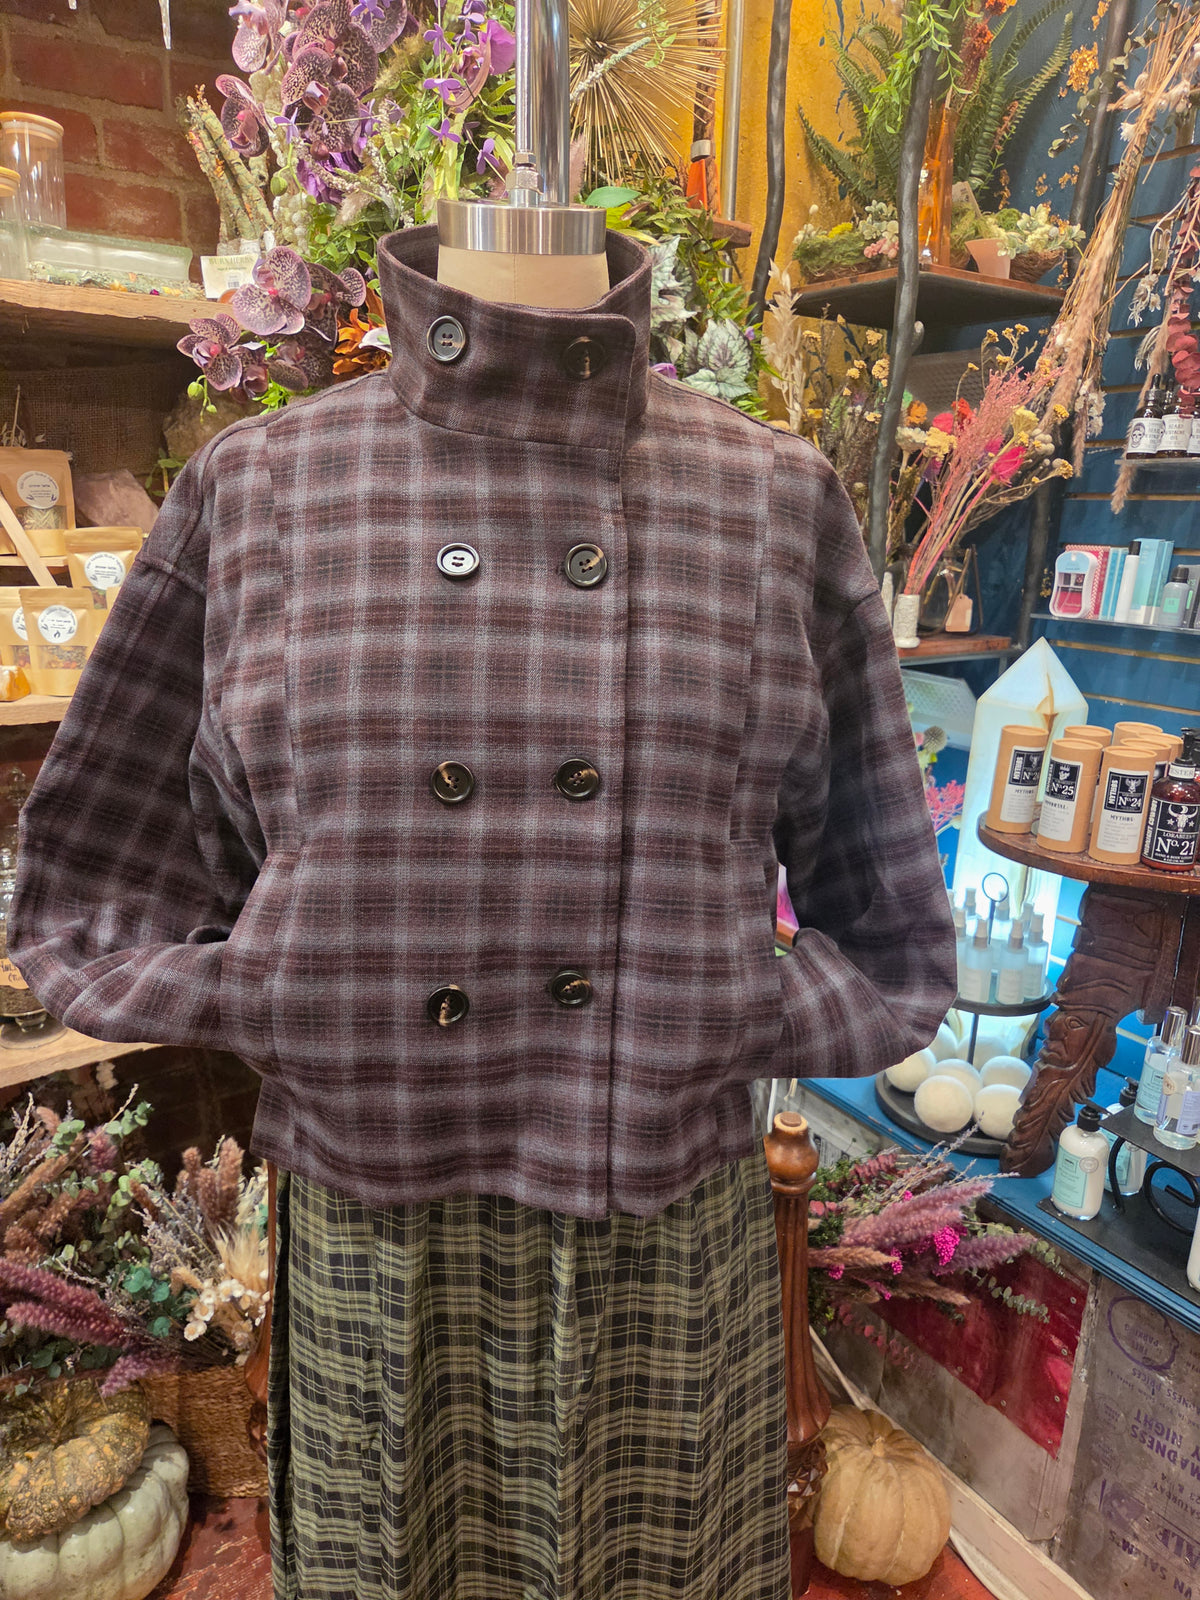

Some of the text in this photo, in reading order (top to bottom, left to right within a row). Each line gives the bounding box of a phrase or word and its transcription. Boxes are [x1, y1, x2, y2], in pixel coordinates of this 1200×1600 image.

[1108, 779, 1118, 805] MYTHOS
[1180, 840, 1195, 856] 21
[1134, 1408, 1183, 1449] NIGHT
[1130, 1424, 1200, 1481] MADNESS
